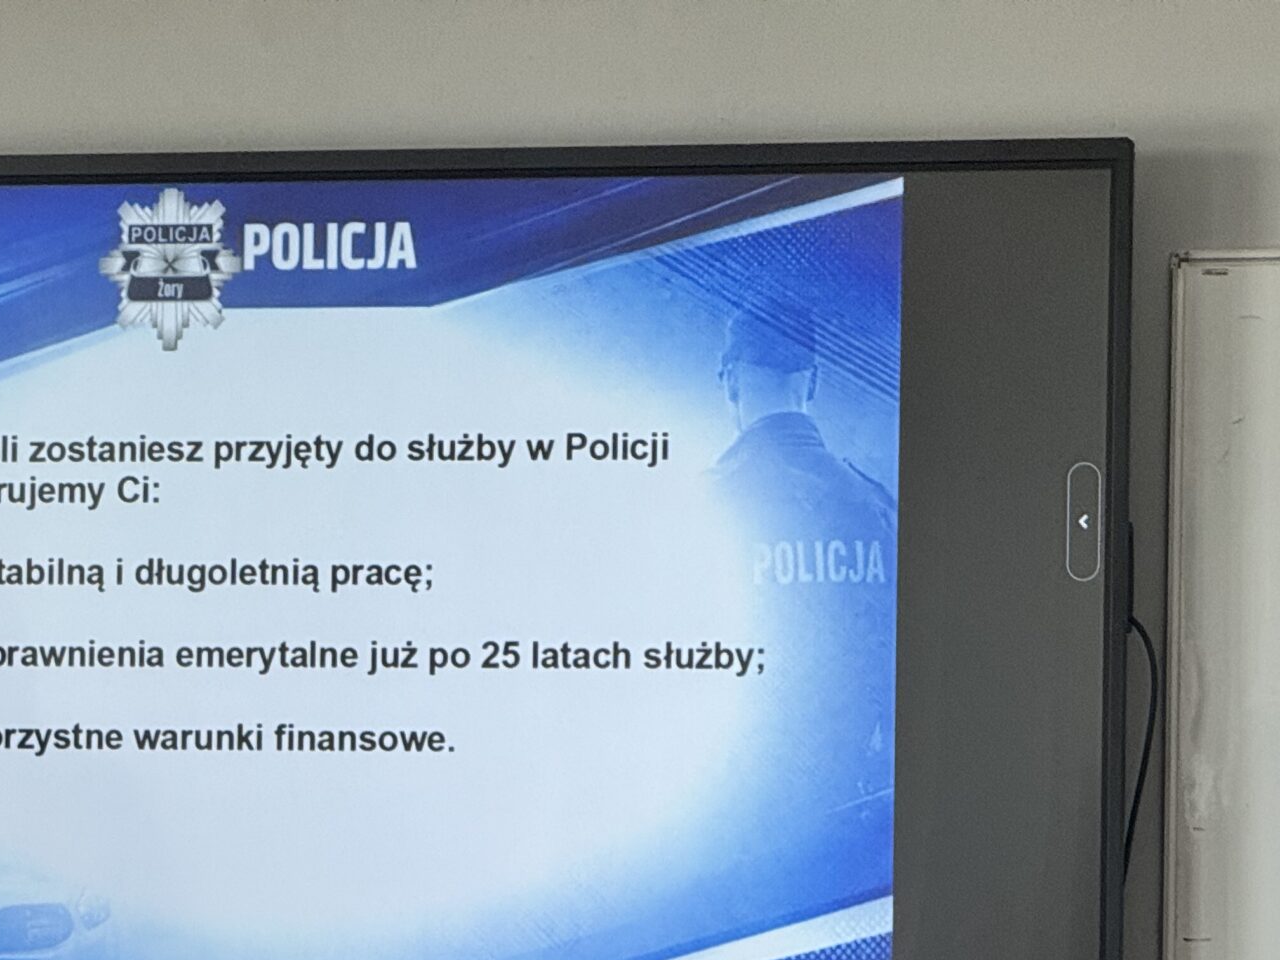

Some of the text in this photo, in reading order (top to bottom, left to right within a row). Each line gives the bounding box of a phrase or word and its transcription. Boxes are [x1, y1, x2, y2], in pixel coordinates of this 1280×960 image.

[130, 226, 212, 243] POLICJA
[242, 221, 418, 271] POLICJA
[157, 278, 184, 299] Żory
[28, 434, 204, 463] zostaniesz
[214, 433, 344, 470] przyjęty
[354, 433, 397, 462] do
[407, 433, 516, 469] służby
[526, 439, 555, 461] w
[566, 432, 669, 468] Policji
[117, 475, 160, 503] Ci:
[116, 557, 123, 585] i
[135, 557, 320, 593] długoletnią
[331, 564, 433, 593] pracę;
[752, 539, 886, 584] POLICJA
[175, 640, 359, 675] emerytalne
[367, 640, 418, 676] już
[429, 647, 471, 676] po
[481, 640, 521, 669] 25
[532, 641, 631, 669] latach
[644, 641, 765, 677] służby;
[133, 723, 263, 751] warunki
[274, 723, 455, 752] finansowe.
